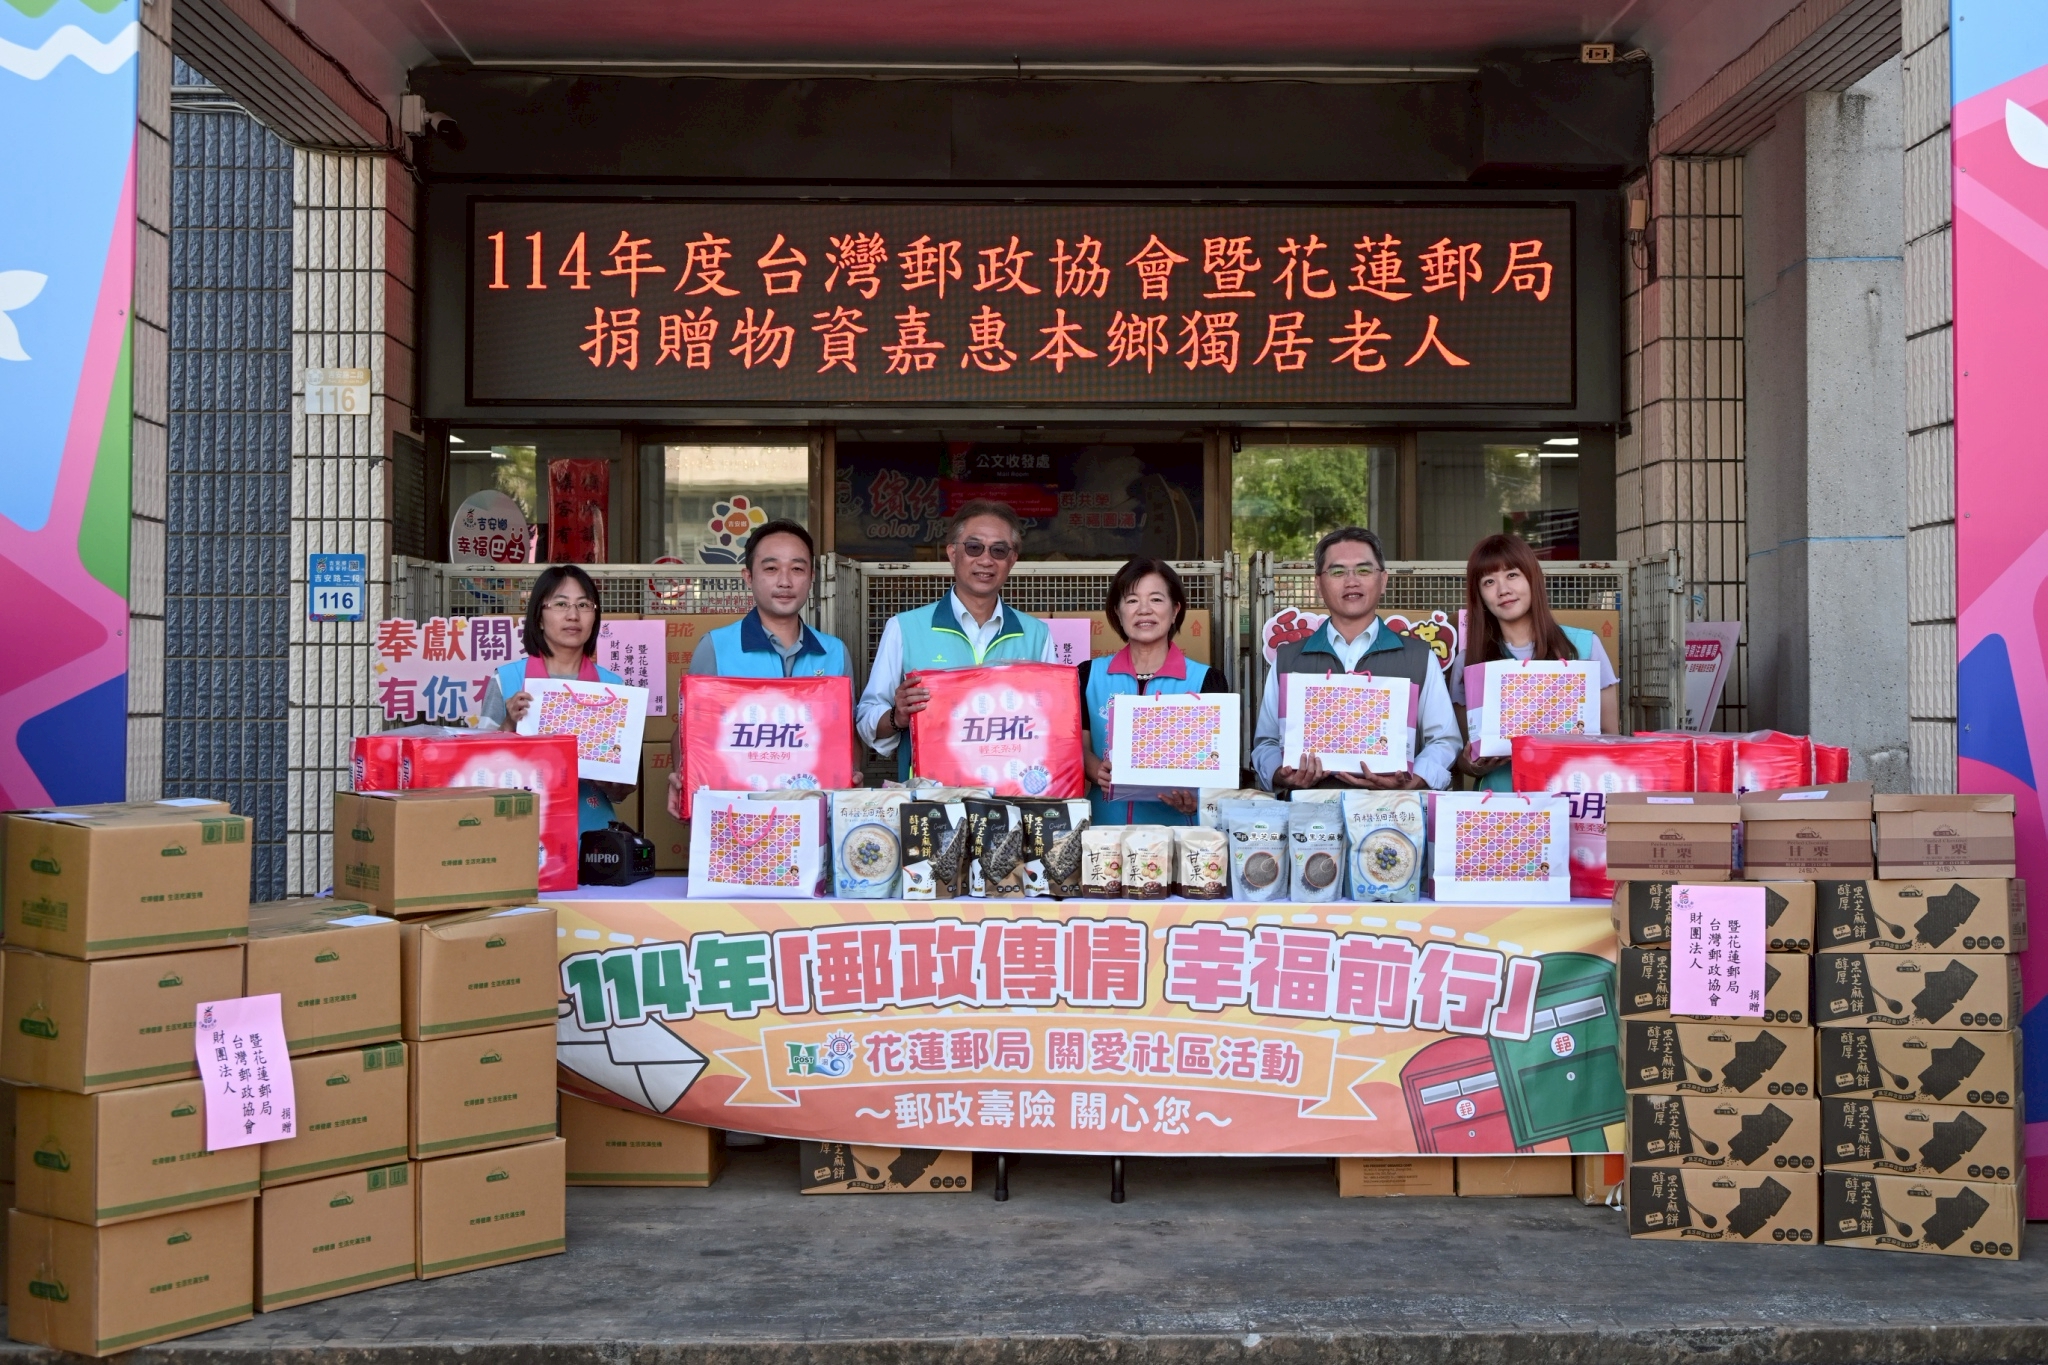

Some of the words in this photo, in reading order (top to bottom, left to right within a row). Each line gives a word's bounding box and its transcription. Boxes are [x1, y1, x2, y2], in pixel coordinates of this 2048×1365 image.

[488, 230, 1553, 302] 114年度台灣郵政協會暨花蓮郵局
[579, 305, 1471, 374] 捐贈物資嘉惠本鄉獨居老人
[315, 387, 355, 412] 116
[976, 453, 1050, 469] 公文收發處
[457, 535, 526, 561] 幸福巴士
[867, 519, 919, 538] color
[319, 592, 354, 609] 116
[377, 619, 529, 663] 奉獻關
[730, 723, 807, 749] 五月花
[961, 715, 1035, 743] 五月花
[585, 853, 620, 864] MIPRO
[1650, 884, 1663, 910] 醇厚
[1837, 884, 1851, 911] 醇厚
[1852, 886, 1867, 939] 黑芝麻餅
[1689, 912, 1703, 970] 財團法人
[1708, 918, 1722, 1007] 台灣郵政協會
[1726, 919, 1741, 994] 暨花蓮郵局
[567, 922, 1141, 1024] 114年「郵政傳情
[1170, 927, 1538, 1035] 幸福前行」
[1641, 953, 1655, 979] 醇厚
[1654, 956, 1669, 1008] 黑芝麻餅
[1835, 958, 1849, 984] 醇厚
[1850, 960, 1864, 1014] 黑芝麻餅
[1749, 989, 1760, 1013] 捐贈
[865, 1029, 1031, 1074] 花蓮郵局
[1048, 1030, 1301, 1084] 關愛社區活動
[1647, 1026, 1661, 1053] 醇厚
[1661, 1029, 1675, 1081] 黑芝麻餅
[1840, 1032, 1855, 1059] 醇厚
[1855, 1035, 1870, 1088] 黑芝麻餅
[213, 1029, 236, 1095] 財團法人
[249, 1032, 272, 1116] 暨花蓮郵局
[232, 1034, 256, 1135] 台灣郵政協會
[281, 1107, 292, 1134] 捐贈
[1667, 1102, 1681, 1154] 黑芝麻餅
[1843, 1102, 1857, 1128] 醇厚
[1857, 1105, 1872, 1159] 黑芝麻餅
[1652, 1171, 1666, 1198] 醇厚
[1665, 1175, 1680, 1227] 黑芝麻餅
[1845, 1177, 1859, 1204] 醇厚
[1859, 1181, 1874, 1235] 黑芝麻餅
